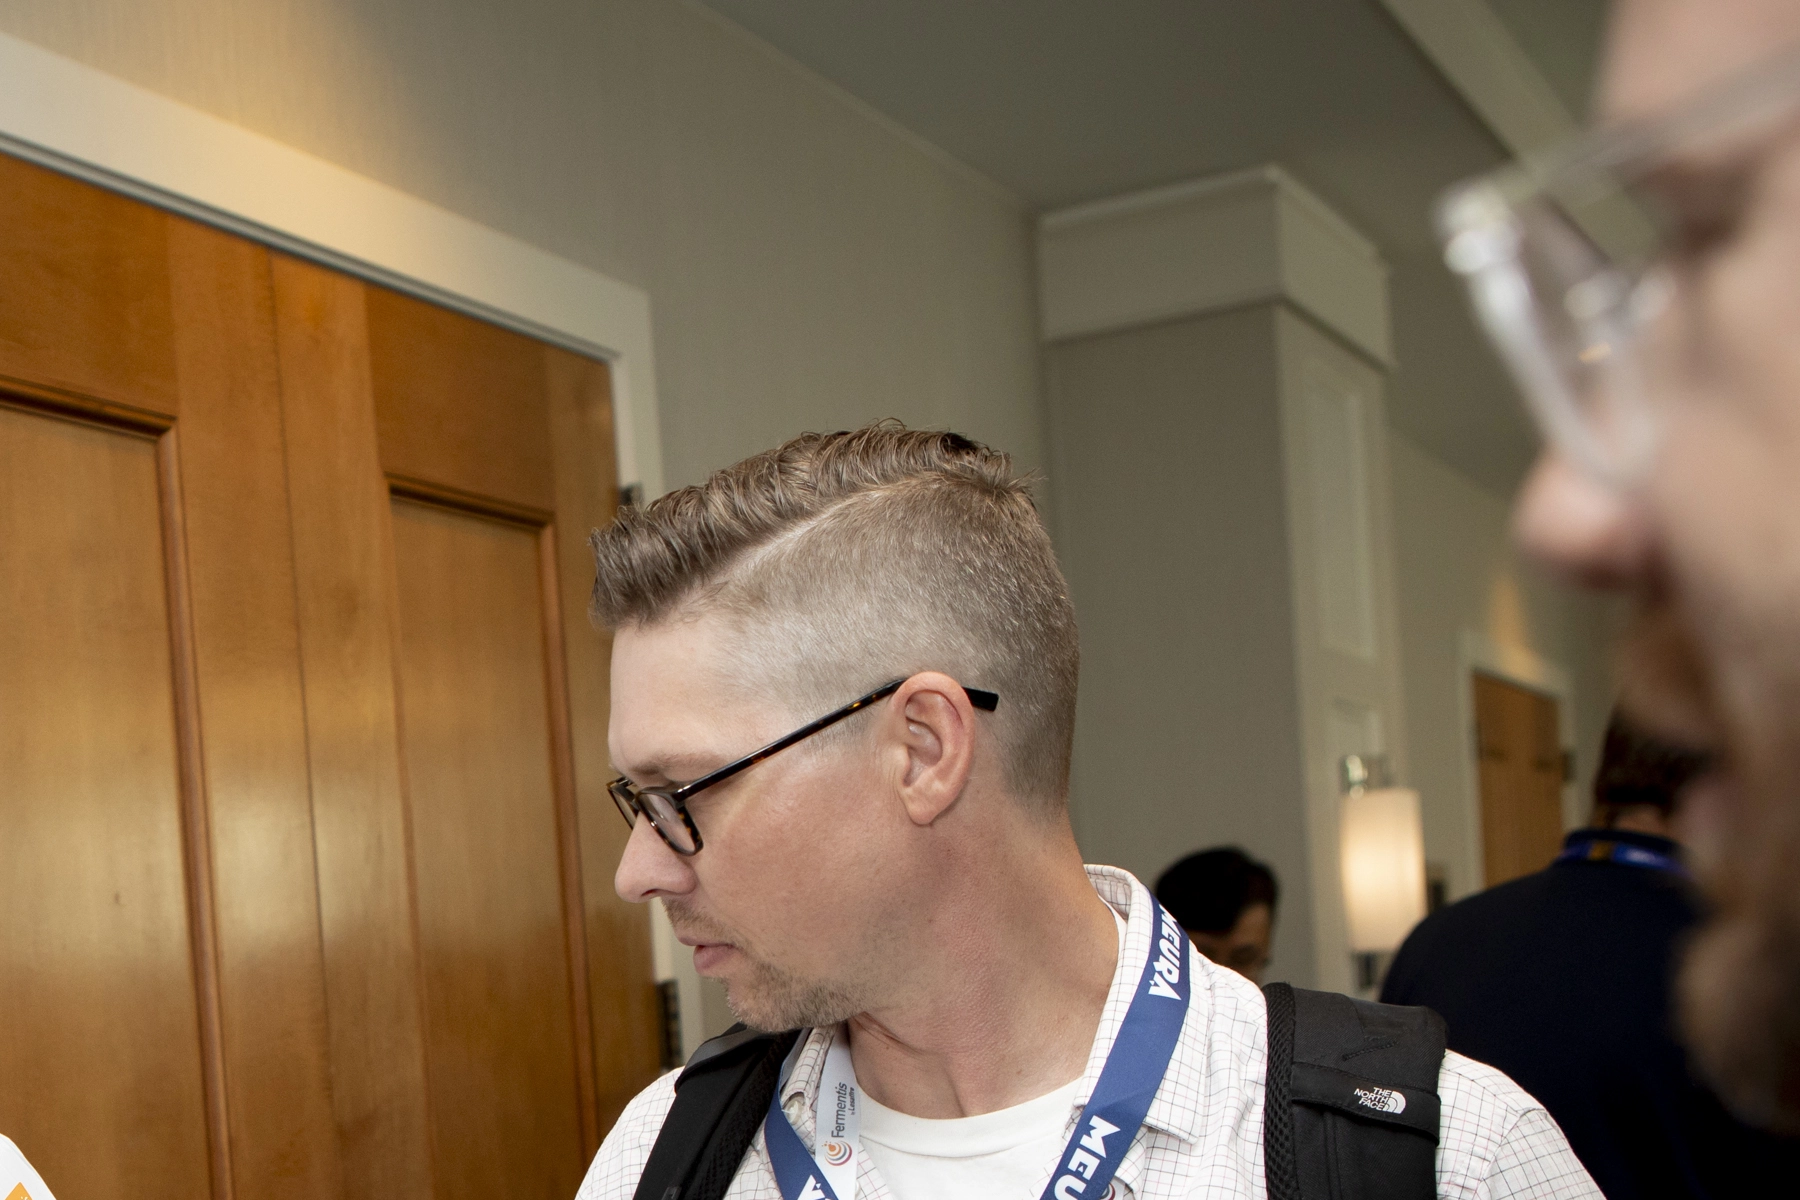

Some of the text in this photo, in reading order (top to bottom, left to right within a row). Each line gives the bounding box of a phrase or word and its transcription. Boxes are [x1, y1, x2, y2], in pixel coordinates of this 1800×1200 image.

[1148, 904, 1181, 1000] MEURA
[1354, 1088, 1390, 1103] NORTH
[1373, 1087, 1392, 1097] THE
[831, 1081, 848, 1138] Fermentis
[1359, 1098, 1385, 1111] FACE
